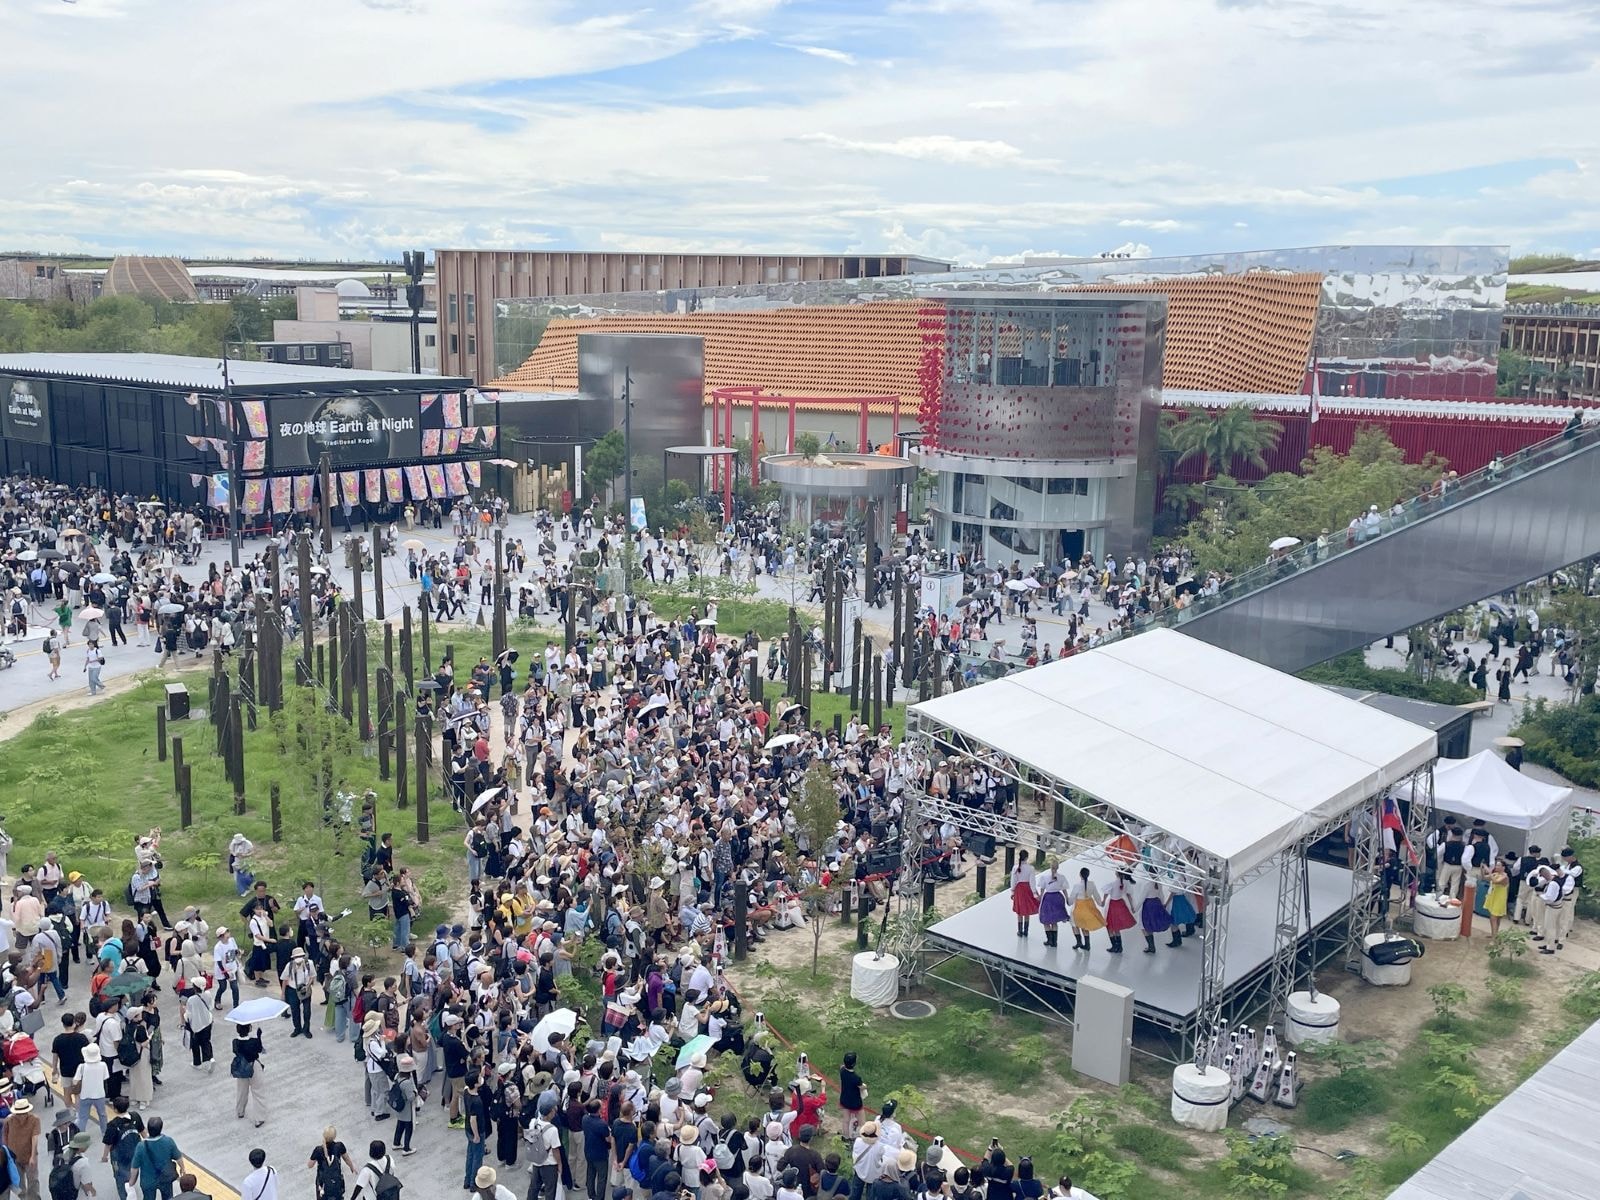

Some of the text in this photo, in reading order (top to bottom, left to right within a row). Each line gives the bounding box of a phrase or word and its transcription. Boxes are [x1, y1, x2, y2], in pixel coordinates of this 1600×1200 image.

[279, 417, 414, 437] 夜の地球 Earth at Night
